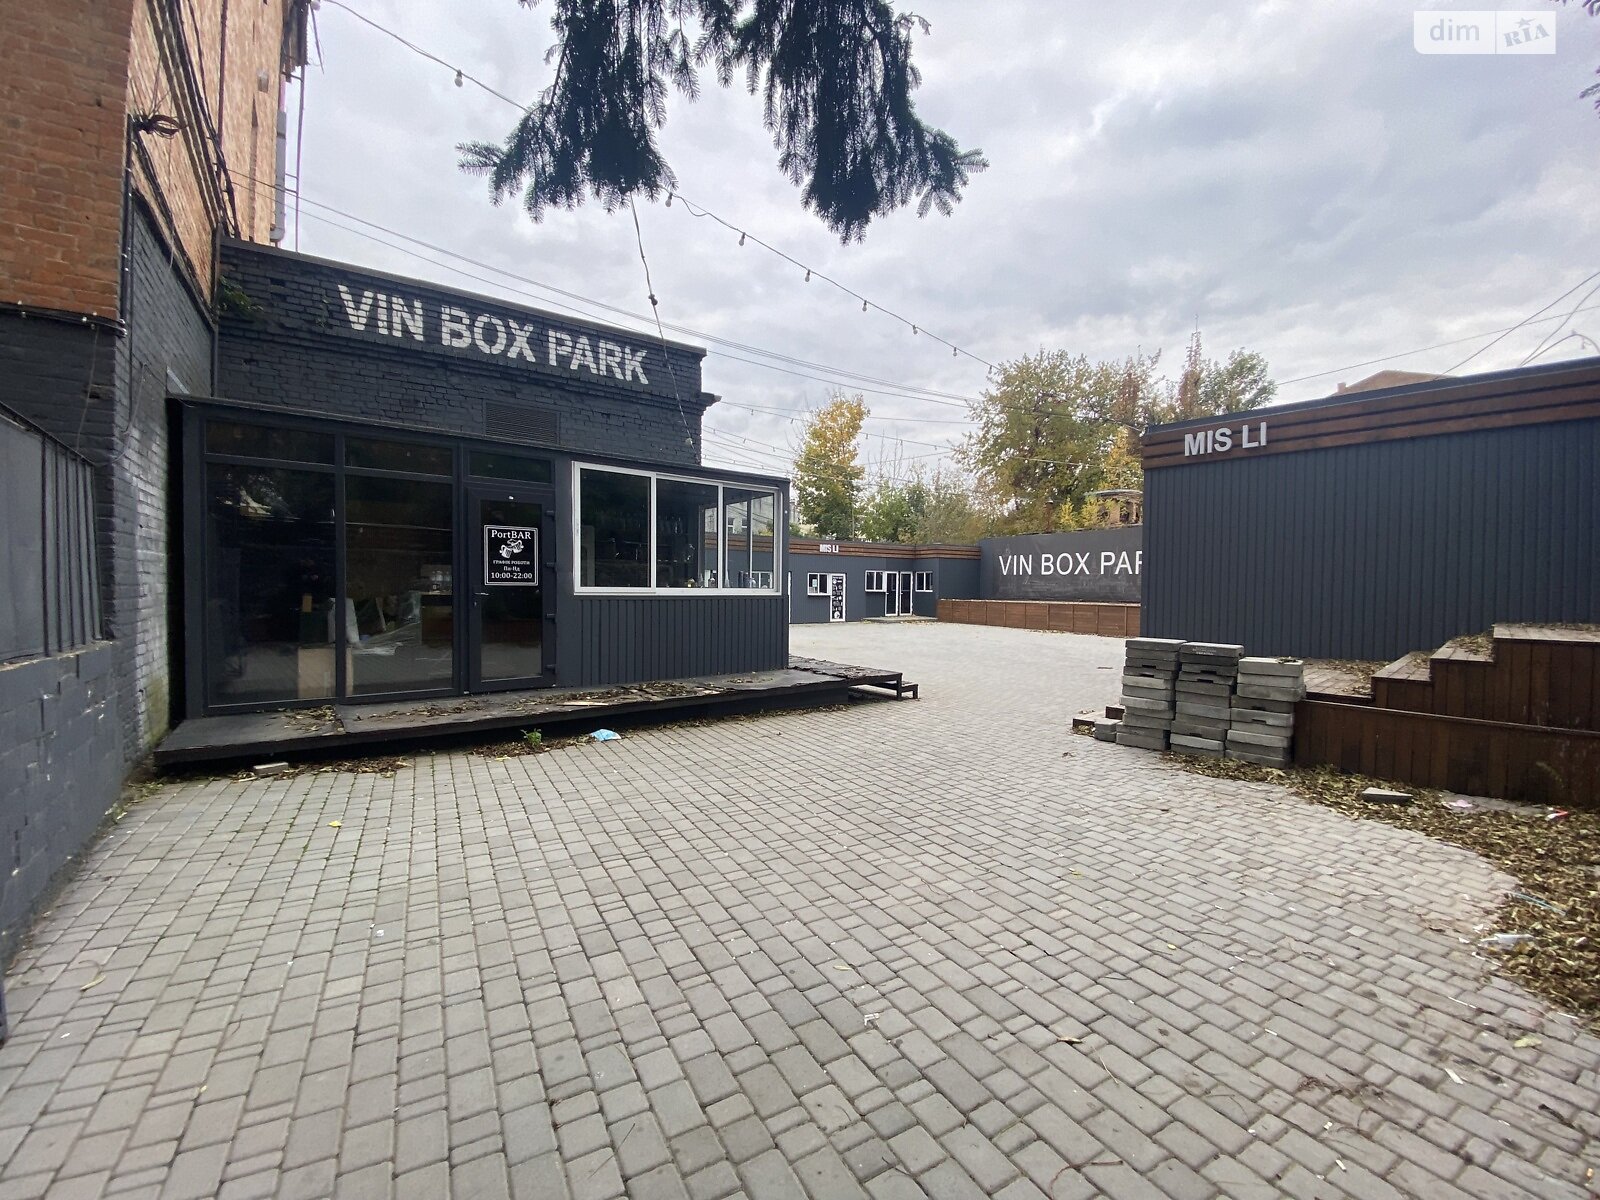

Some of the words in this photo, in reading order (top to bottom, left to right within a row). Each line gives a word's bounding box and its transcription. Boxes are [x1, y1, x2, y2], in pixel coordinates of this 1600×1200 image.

[337, 284, 424, 341] VIN
[441, 305, 536, 362] BOX
[548, 328, 649, 385] PARK
[1184, 427, 1232, 456] MIS
[1242, 421, 1267, 448] LI
[491, 530, 531, 539] PortBAR
[999, 554, 1032, 575] VIN
[1041, 552, 1090, 575] BOX
